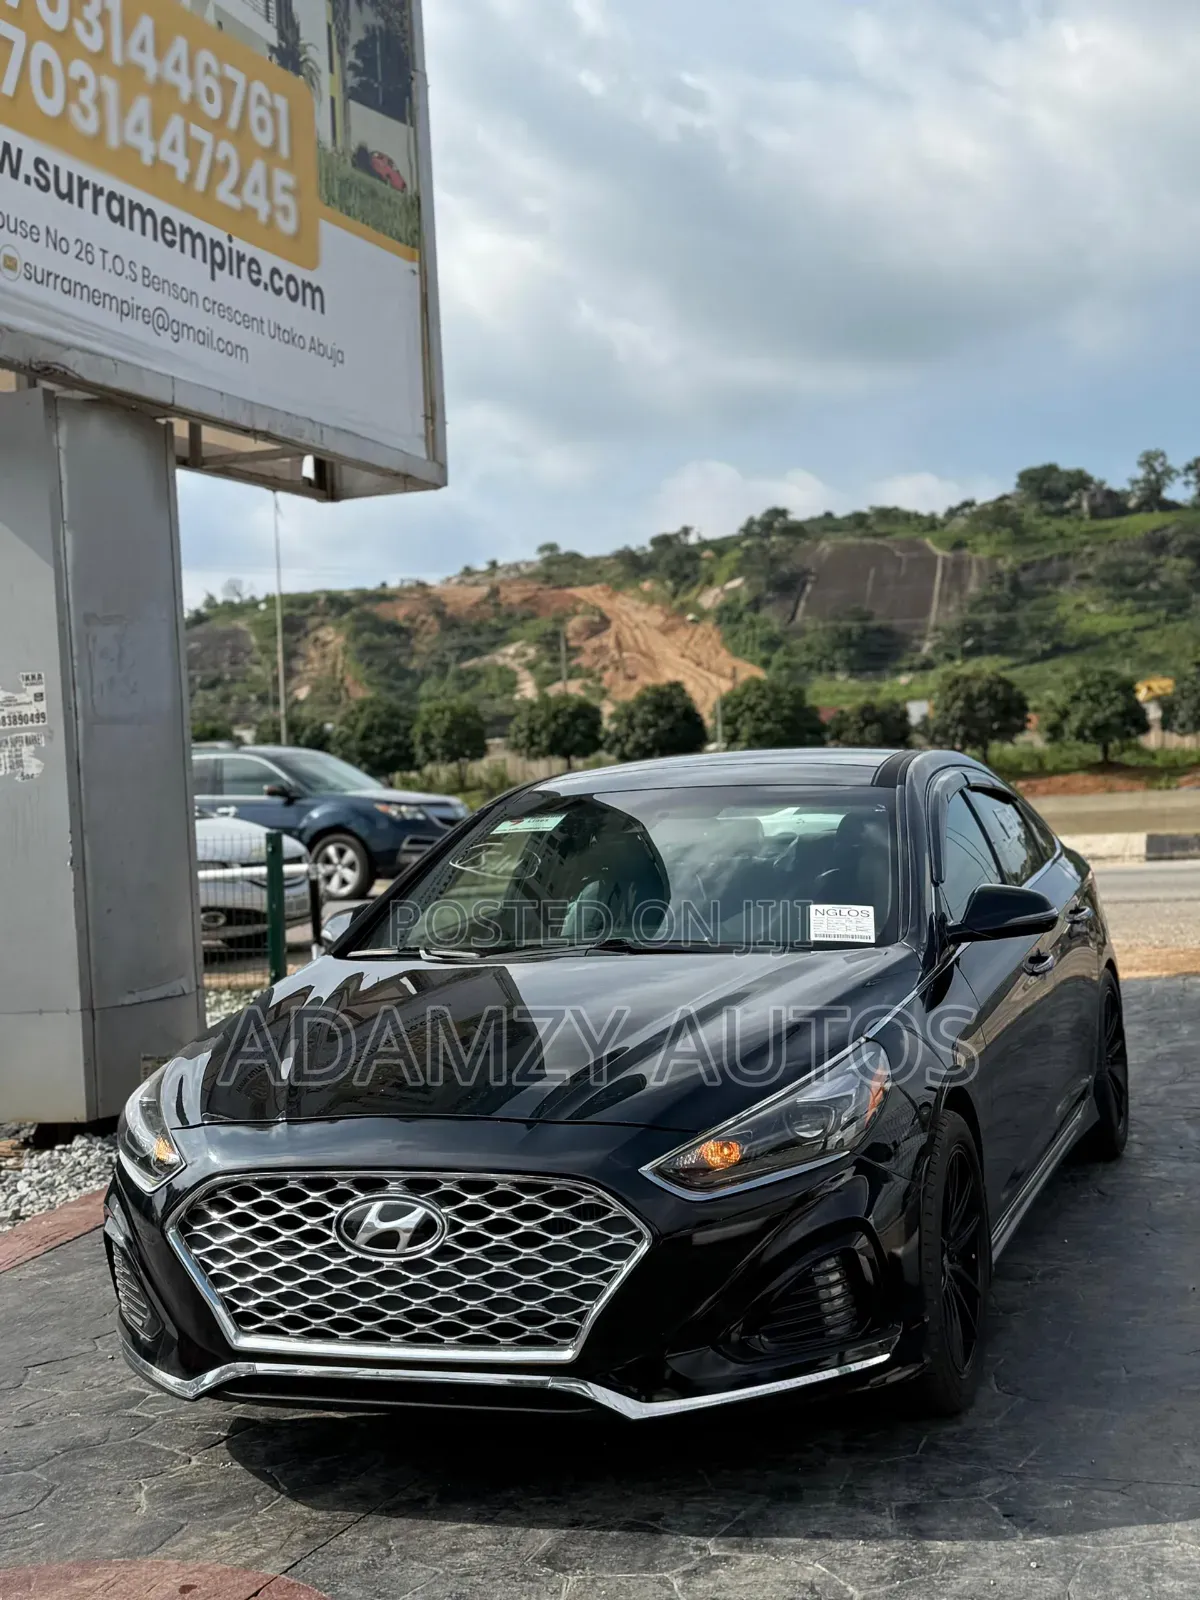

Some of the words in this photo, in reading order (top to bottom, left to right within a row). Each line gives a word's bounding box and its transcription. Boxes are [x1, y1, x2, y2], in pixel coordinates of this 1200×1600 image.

[23, 261, 249, 364] surramempire@gmail.com
[45, 225, 70, 255] No
[74, 238, 95, 266] 26
[99, 247, 138, 283] T.O.S
[141, 265, 199, 309] Benson
[202, 296, 265, 336] crescent
[267, 319, 306, 350] Utako
[308, 335, 345, 368] Abuja
[814, 908, 870, 918] NGLOS
